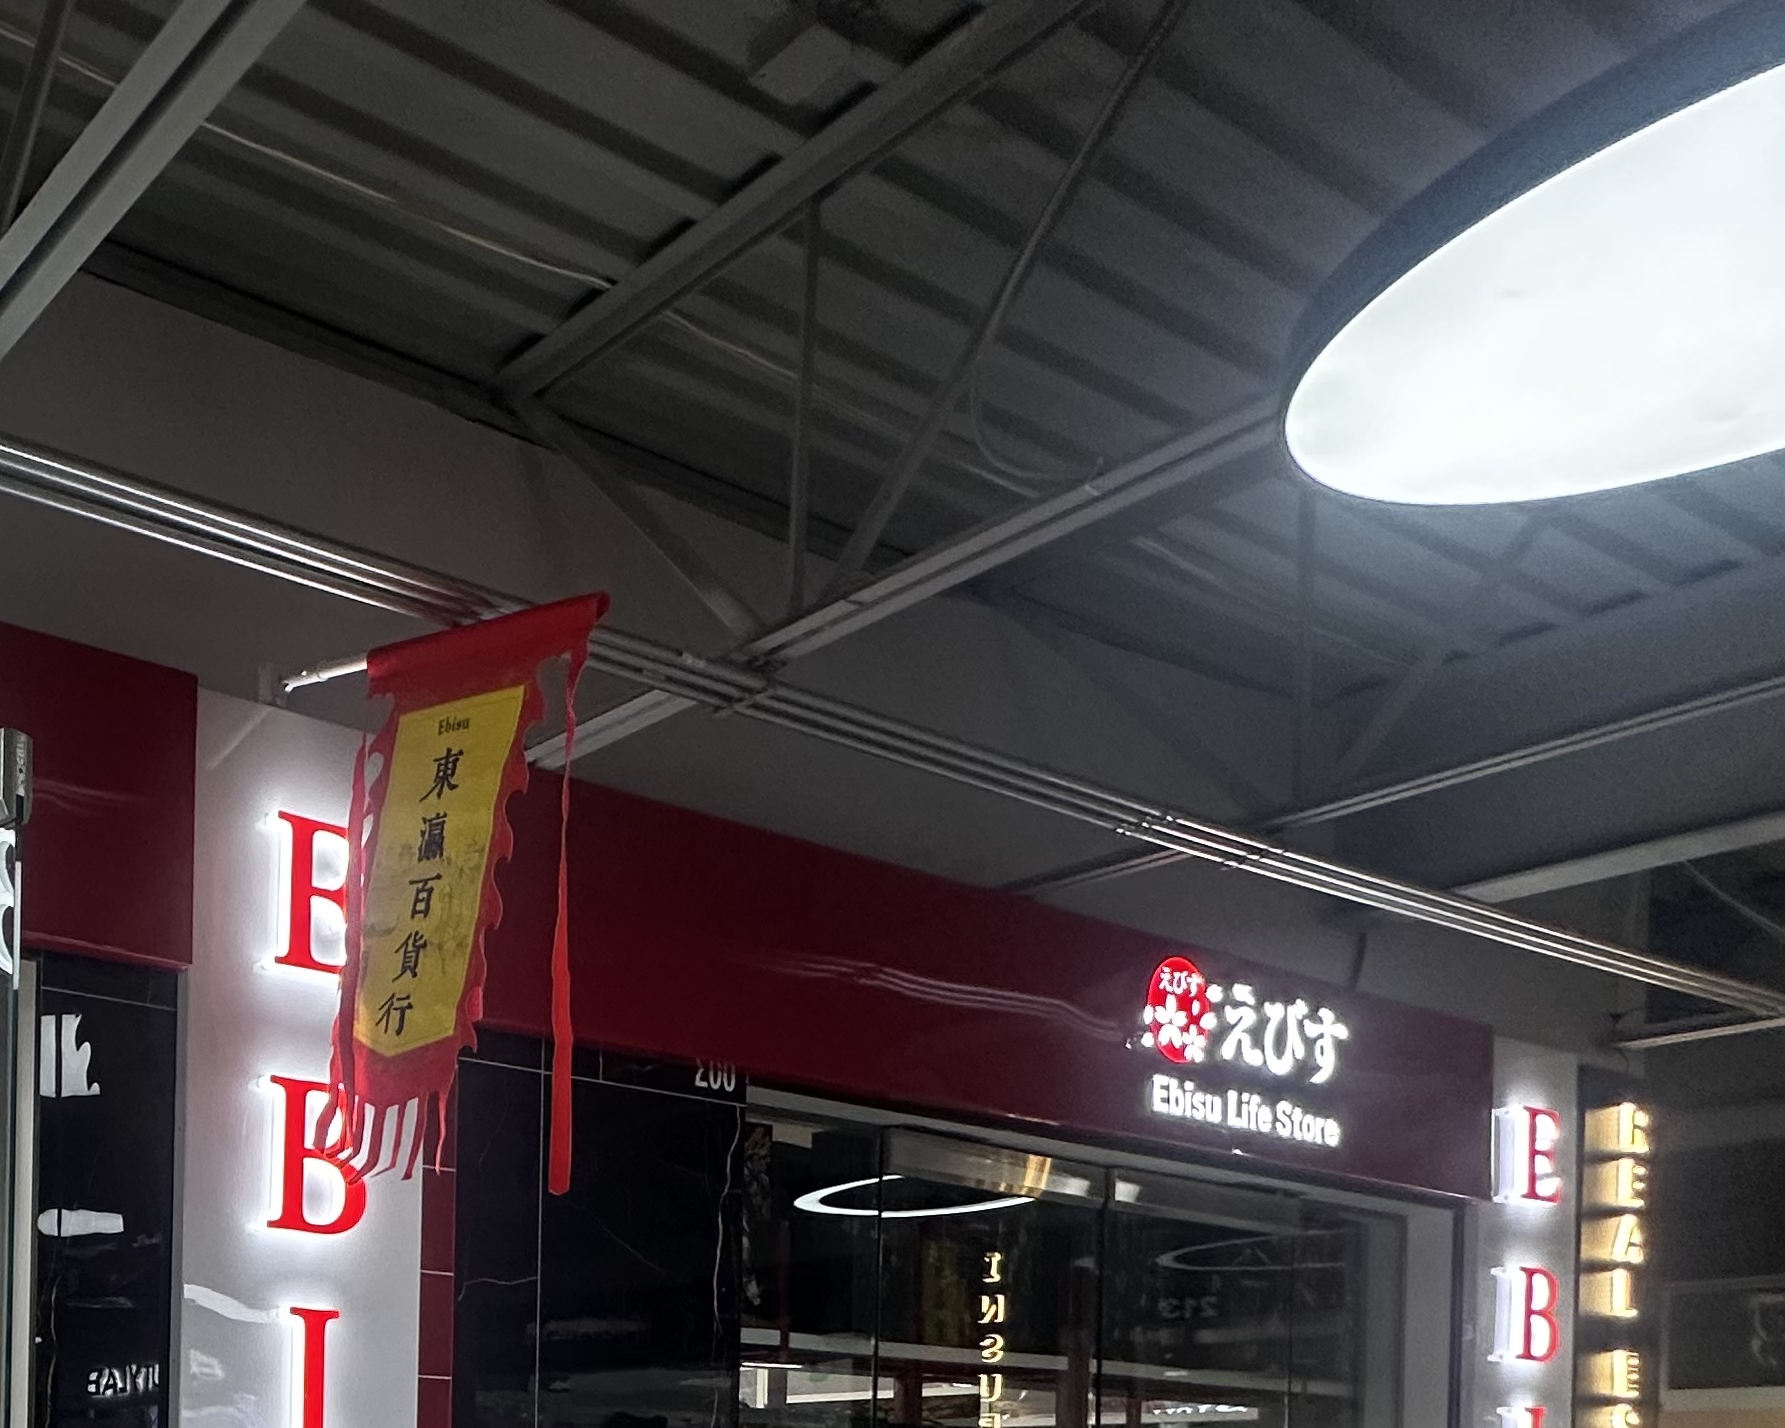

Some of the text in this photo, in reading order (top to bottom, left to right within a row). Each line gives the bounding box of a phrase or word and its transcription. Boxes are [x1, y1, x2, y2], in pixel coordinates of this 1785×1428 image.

[437, 717, 471, 736] Ebisu
[375, 747, 464, 1037] 東瀛百貨行
[1221, 984, 1349, 1084] えびす
[1151, 1073, 1342, 1148] Ebisu Life Store
